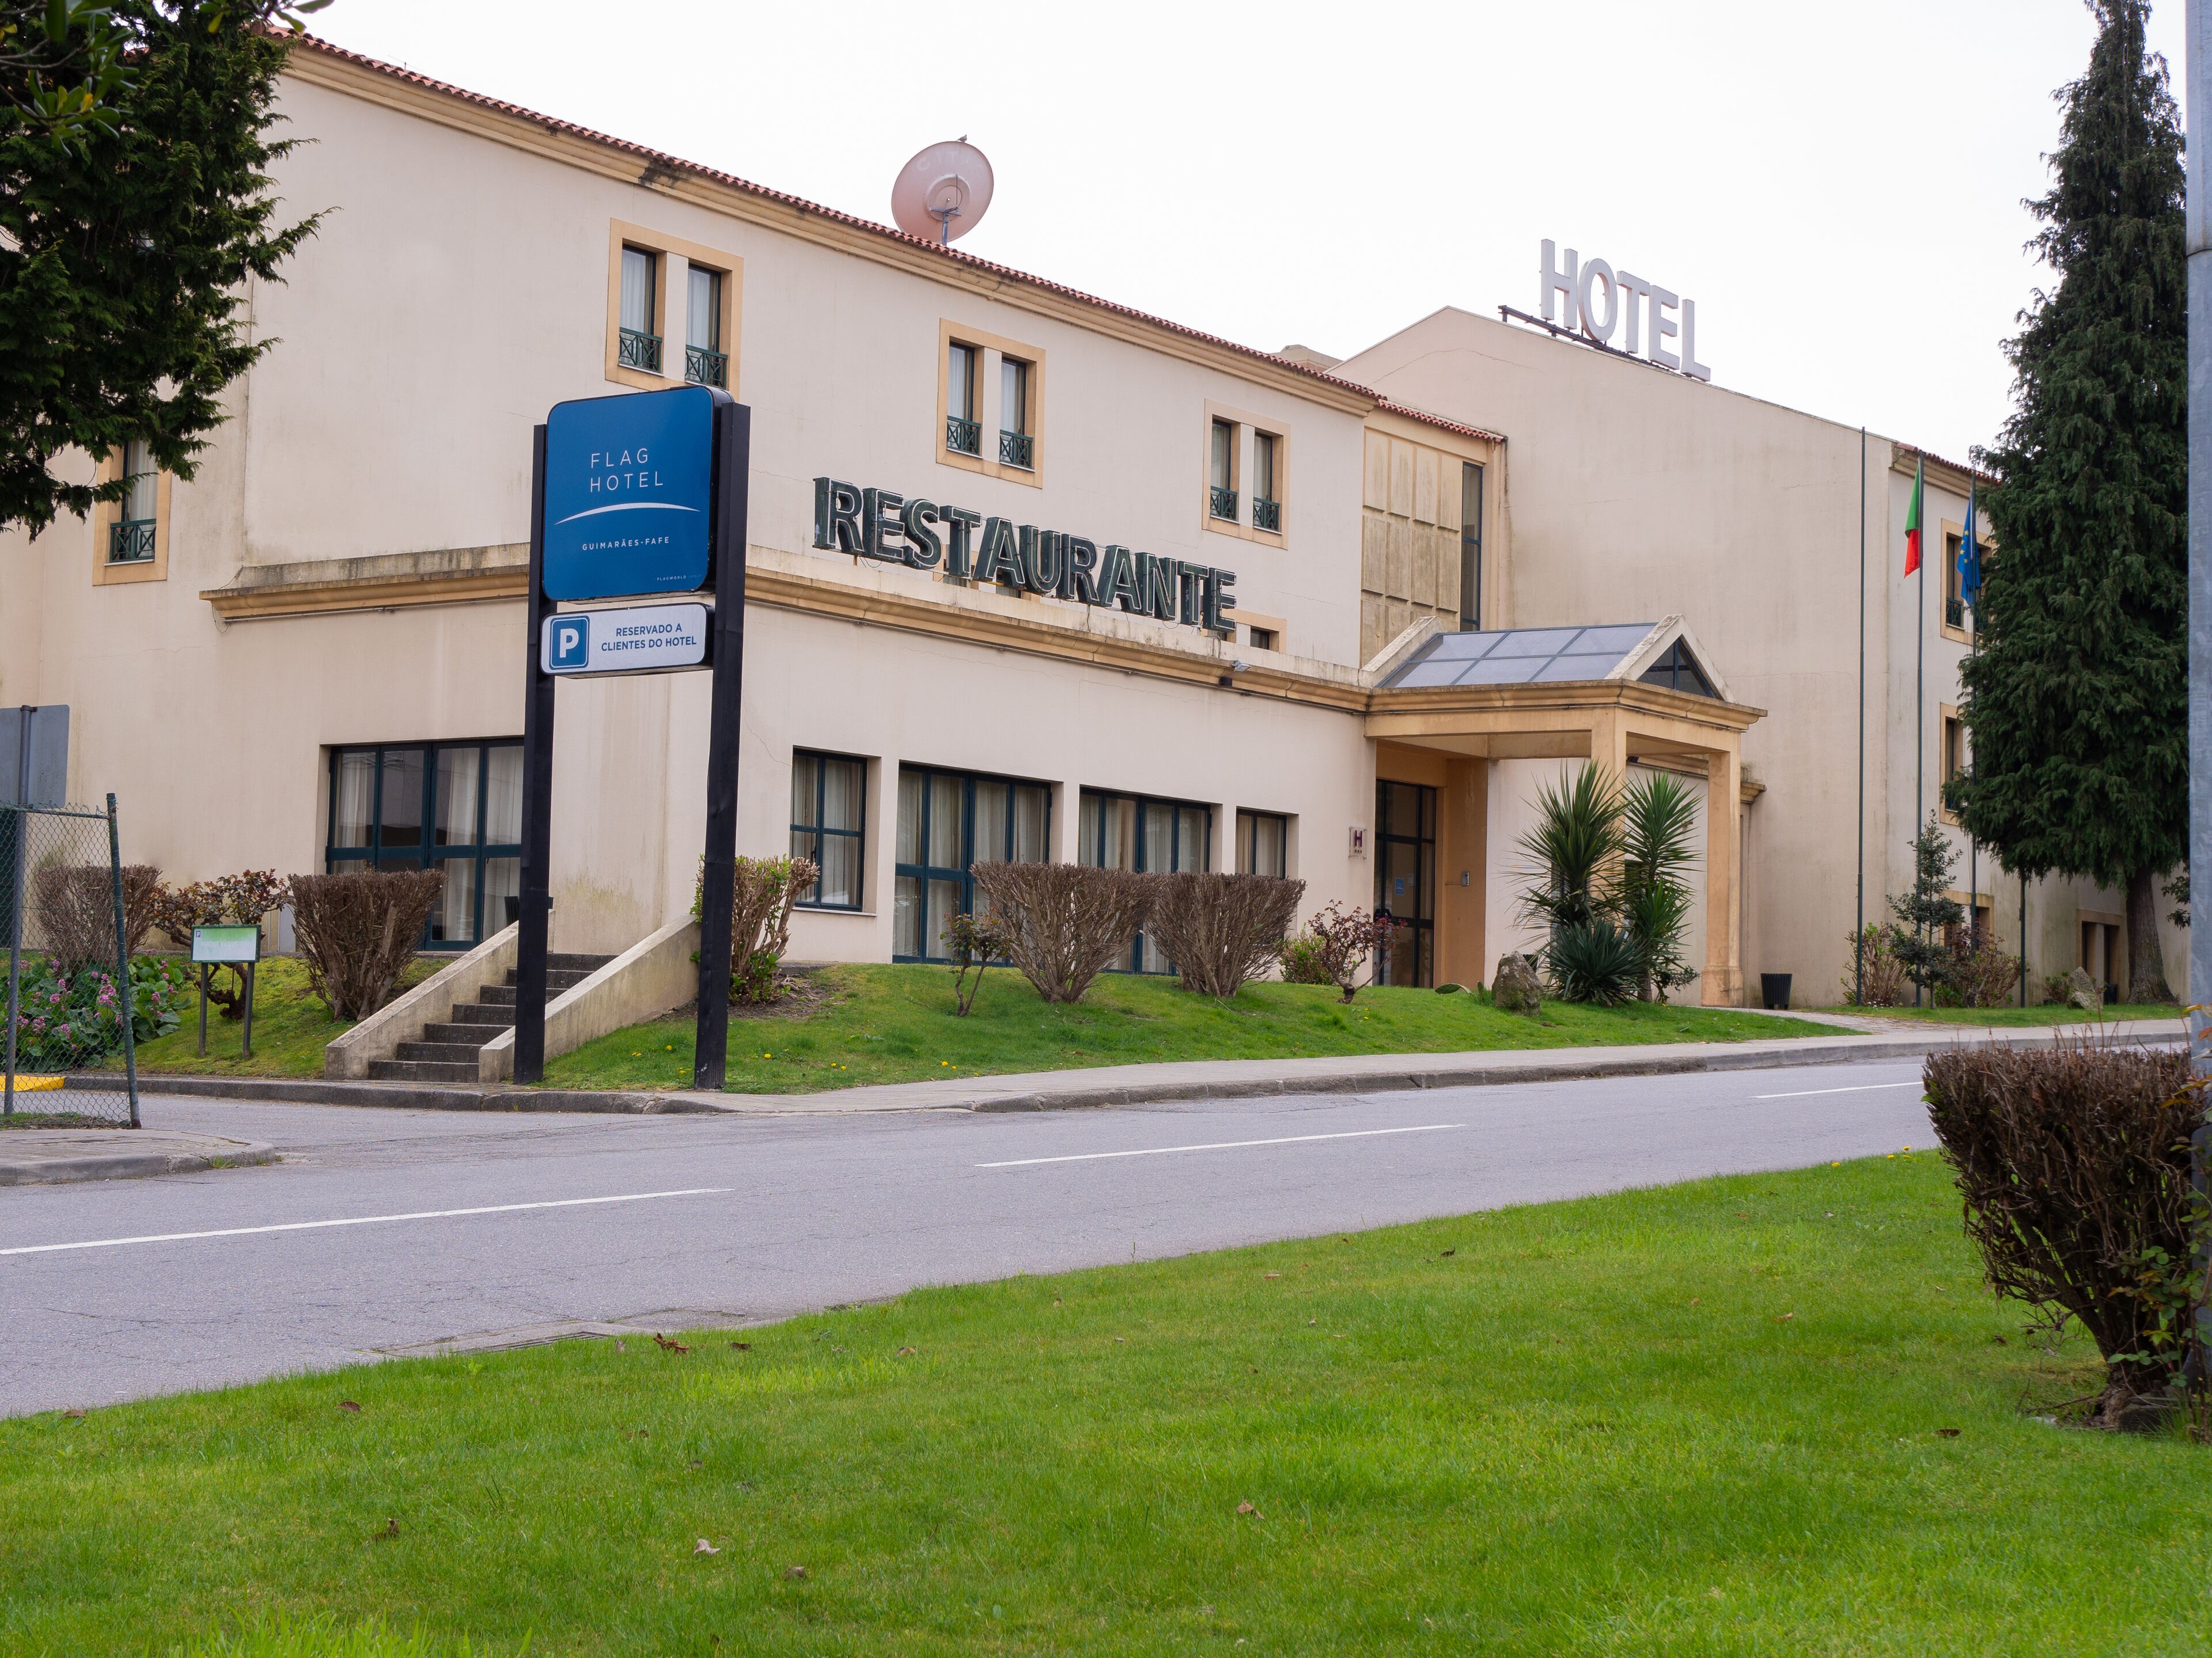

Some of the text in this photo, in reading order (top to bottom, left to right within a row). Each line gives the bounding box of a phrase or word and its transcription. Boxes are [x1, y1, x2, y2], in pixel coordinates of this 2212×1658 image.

[1540, 238, 1711, 382] HOTEL
[590, 447, 649, 469] FLAG
[590, 471, 664, 493] HOTEL
[582, 536, 670, 551] GUIMARÃES-FAFE
[813, 477, 1237, 633] RESTAURANTE
[616, 623, 683, 637] RESERVADO A
[559, 628, 579, 658] P
[601, 636, 697, 651] CLIENTES DO HOTEL
[1354, 829, 1363, 848] H
